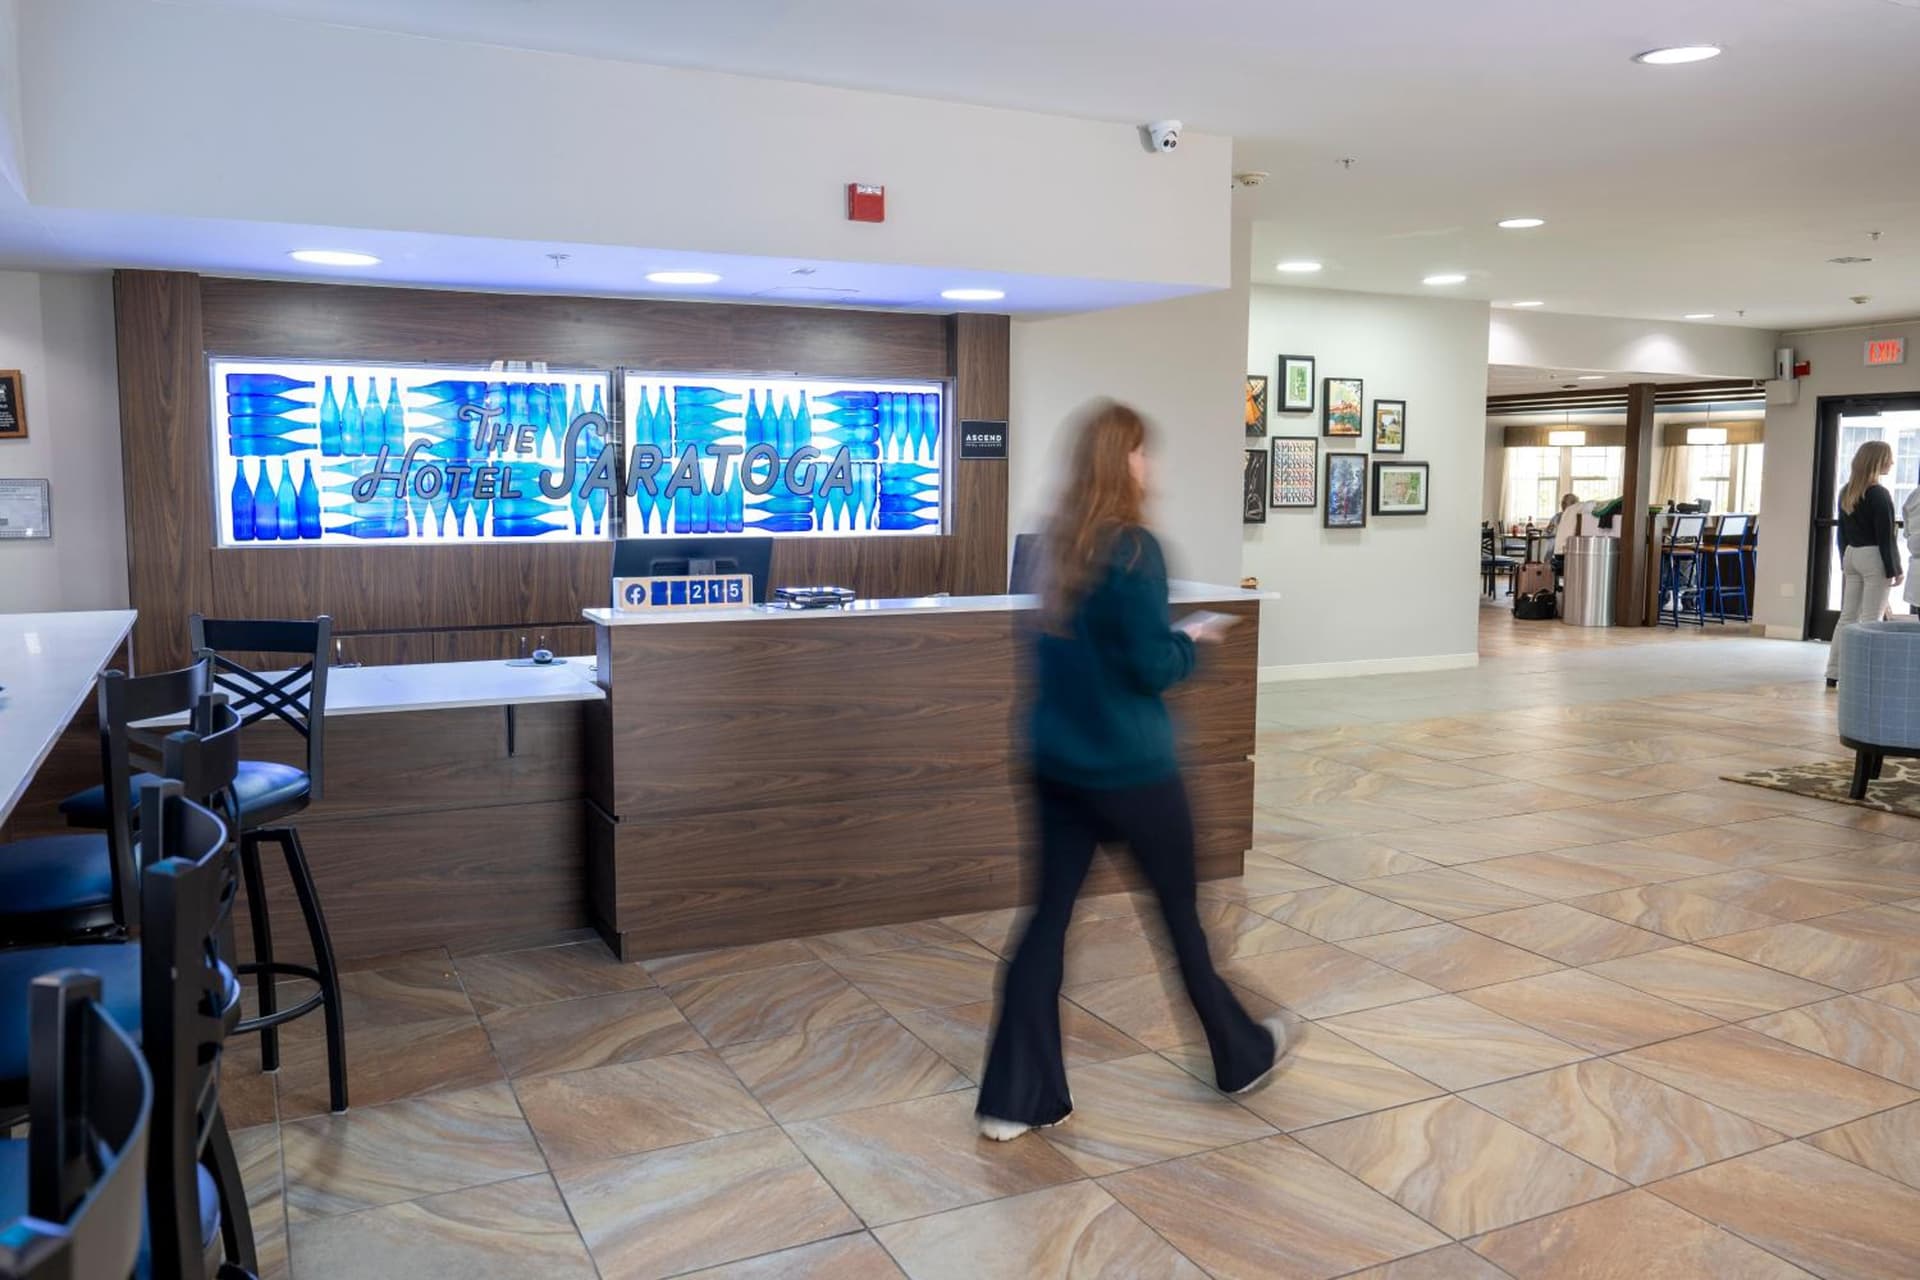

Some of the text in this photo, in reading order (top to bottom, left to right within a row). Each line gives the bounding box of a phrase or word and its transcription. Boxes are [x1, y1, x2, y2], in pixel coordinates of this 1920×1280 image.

[1869, 340, 1897, 362] EXIT
[458, 404, 538, 453] THE
[351, 411, 853, 503] HOTEL SARATOGA
